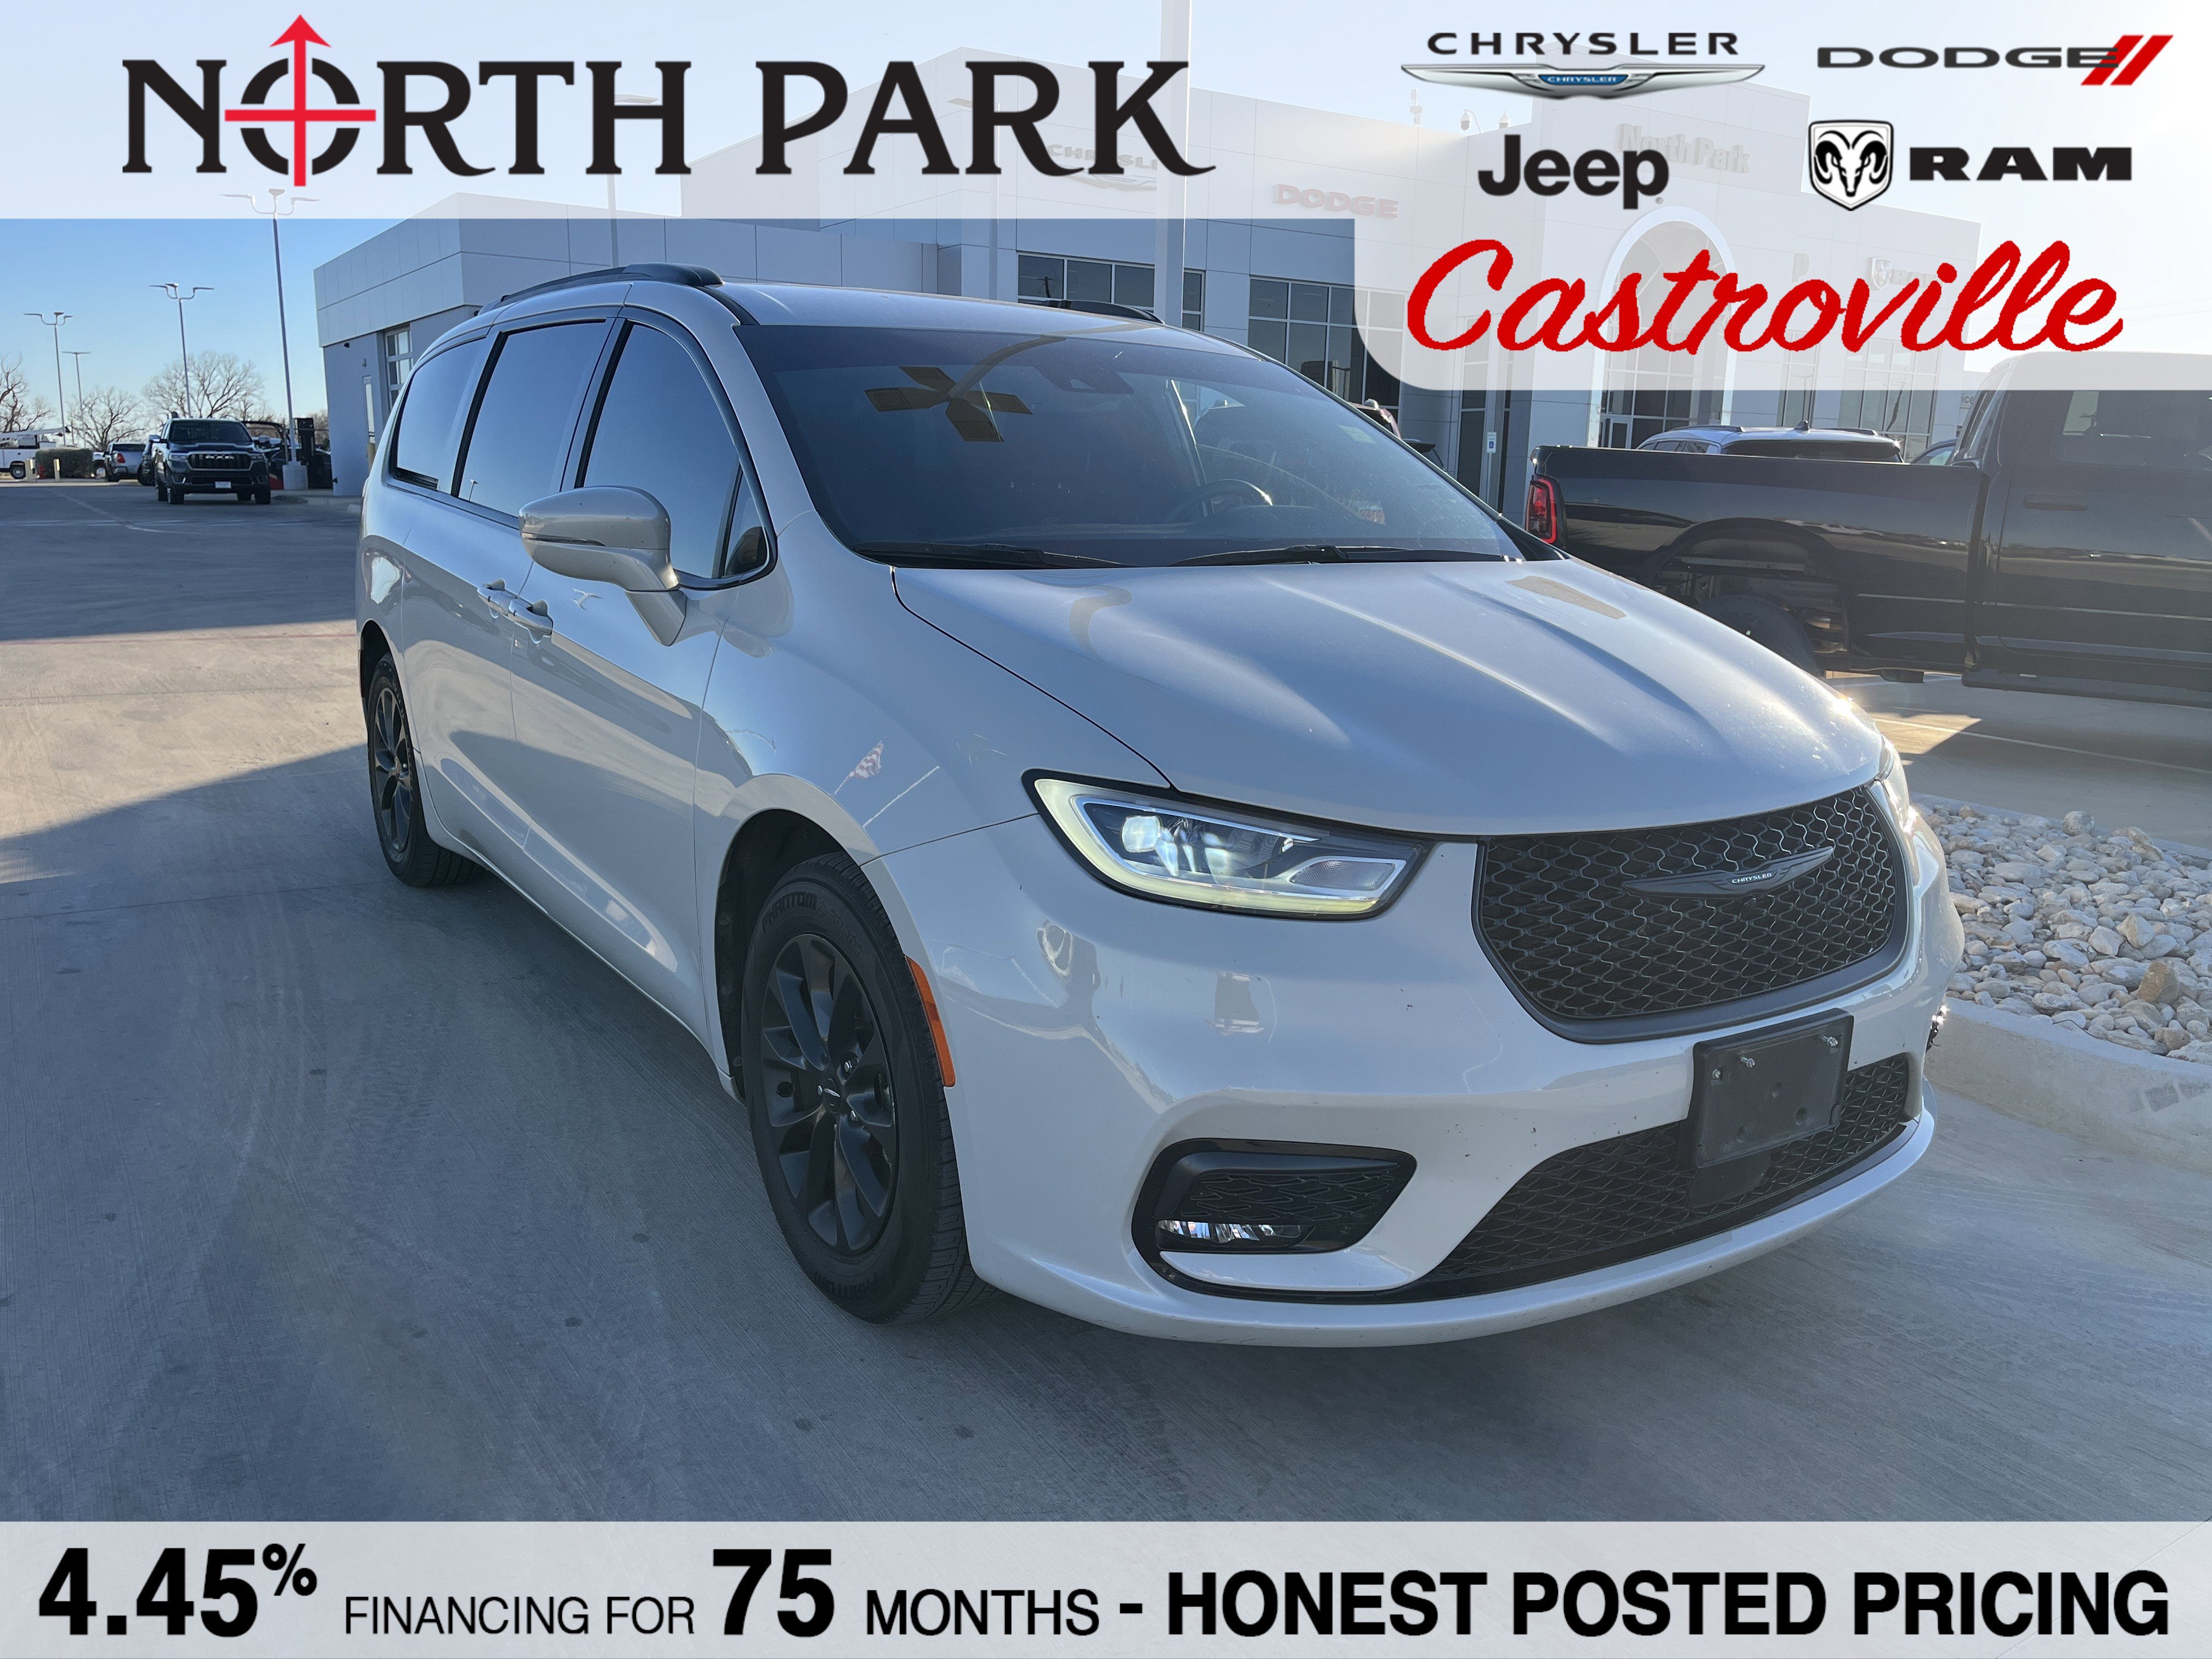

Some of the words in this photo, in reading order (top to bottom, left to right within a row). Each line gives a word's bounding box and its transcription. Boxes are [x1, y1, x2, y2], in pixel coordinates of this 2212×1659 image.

[1614, 123, 1691, 163] North
[1692, 137, 1751, 173] Park
[1272, 183, 1399, 219] DODGE
[1731, 872, 1773, 884] CHRYSLER
[761, 891, 818, 934] PHANTOM
